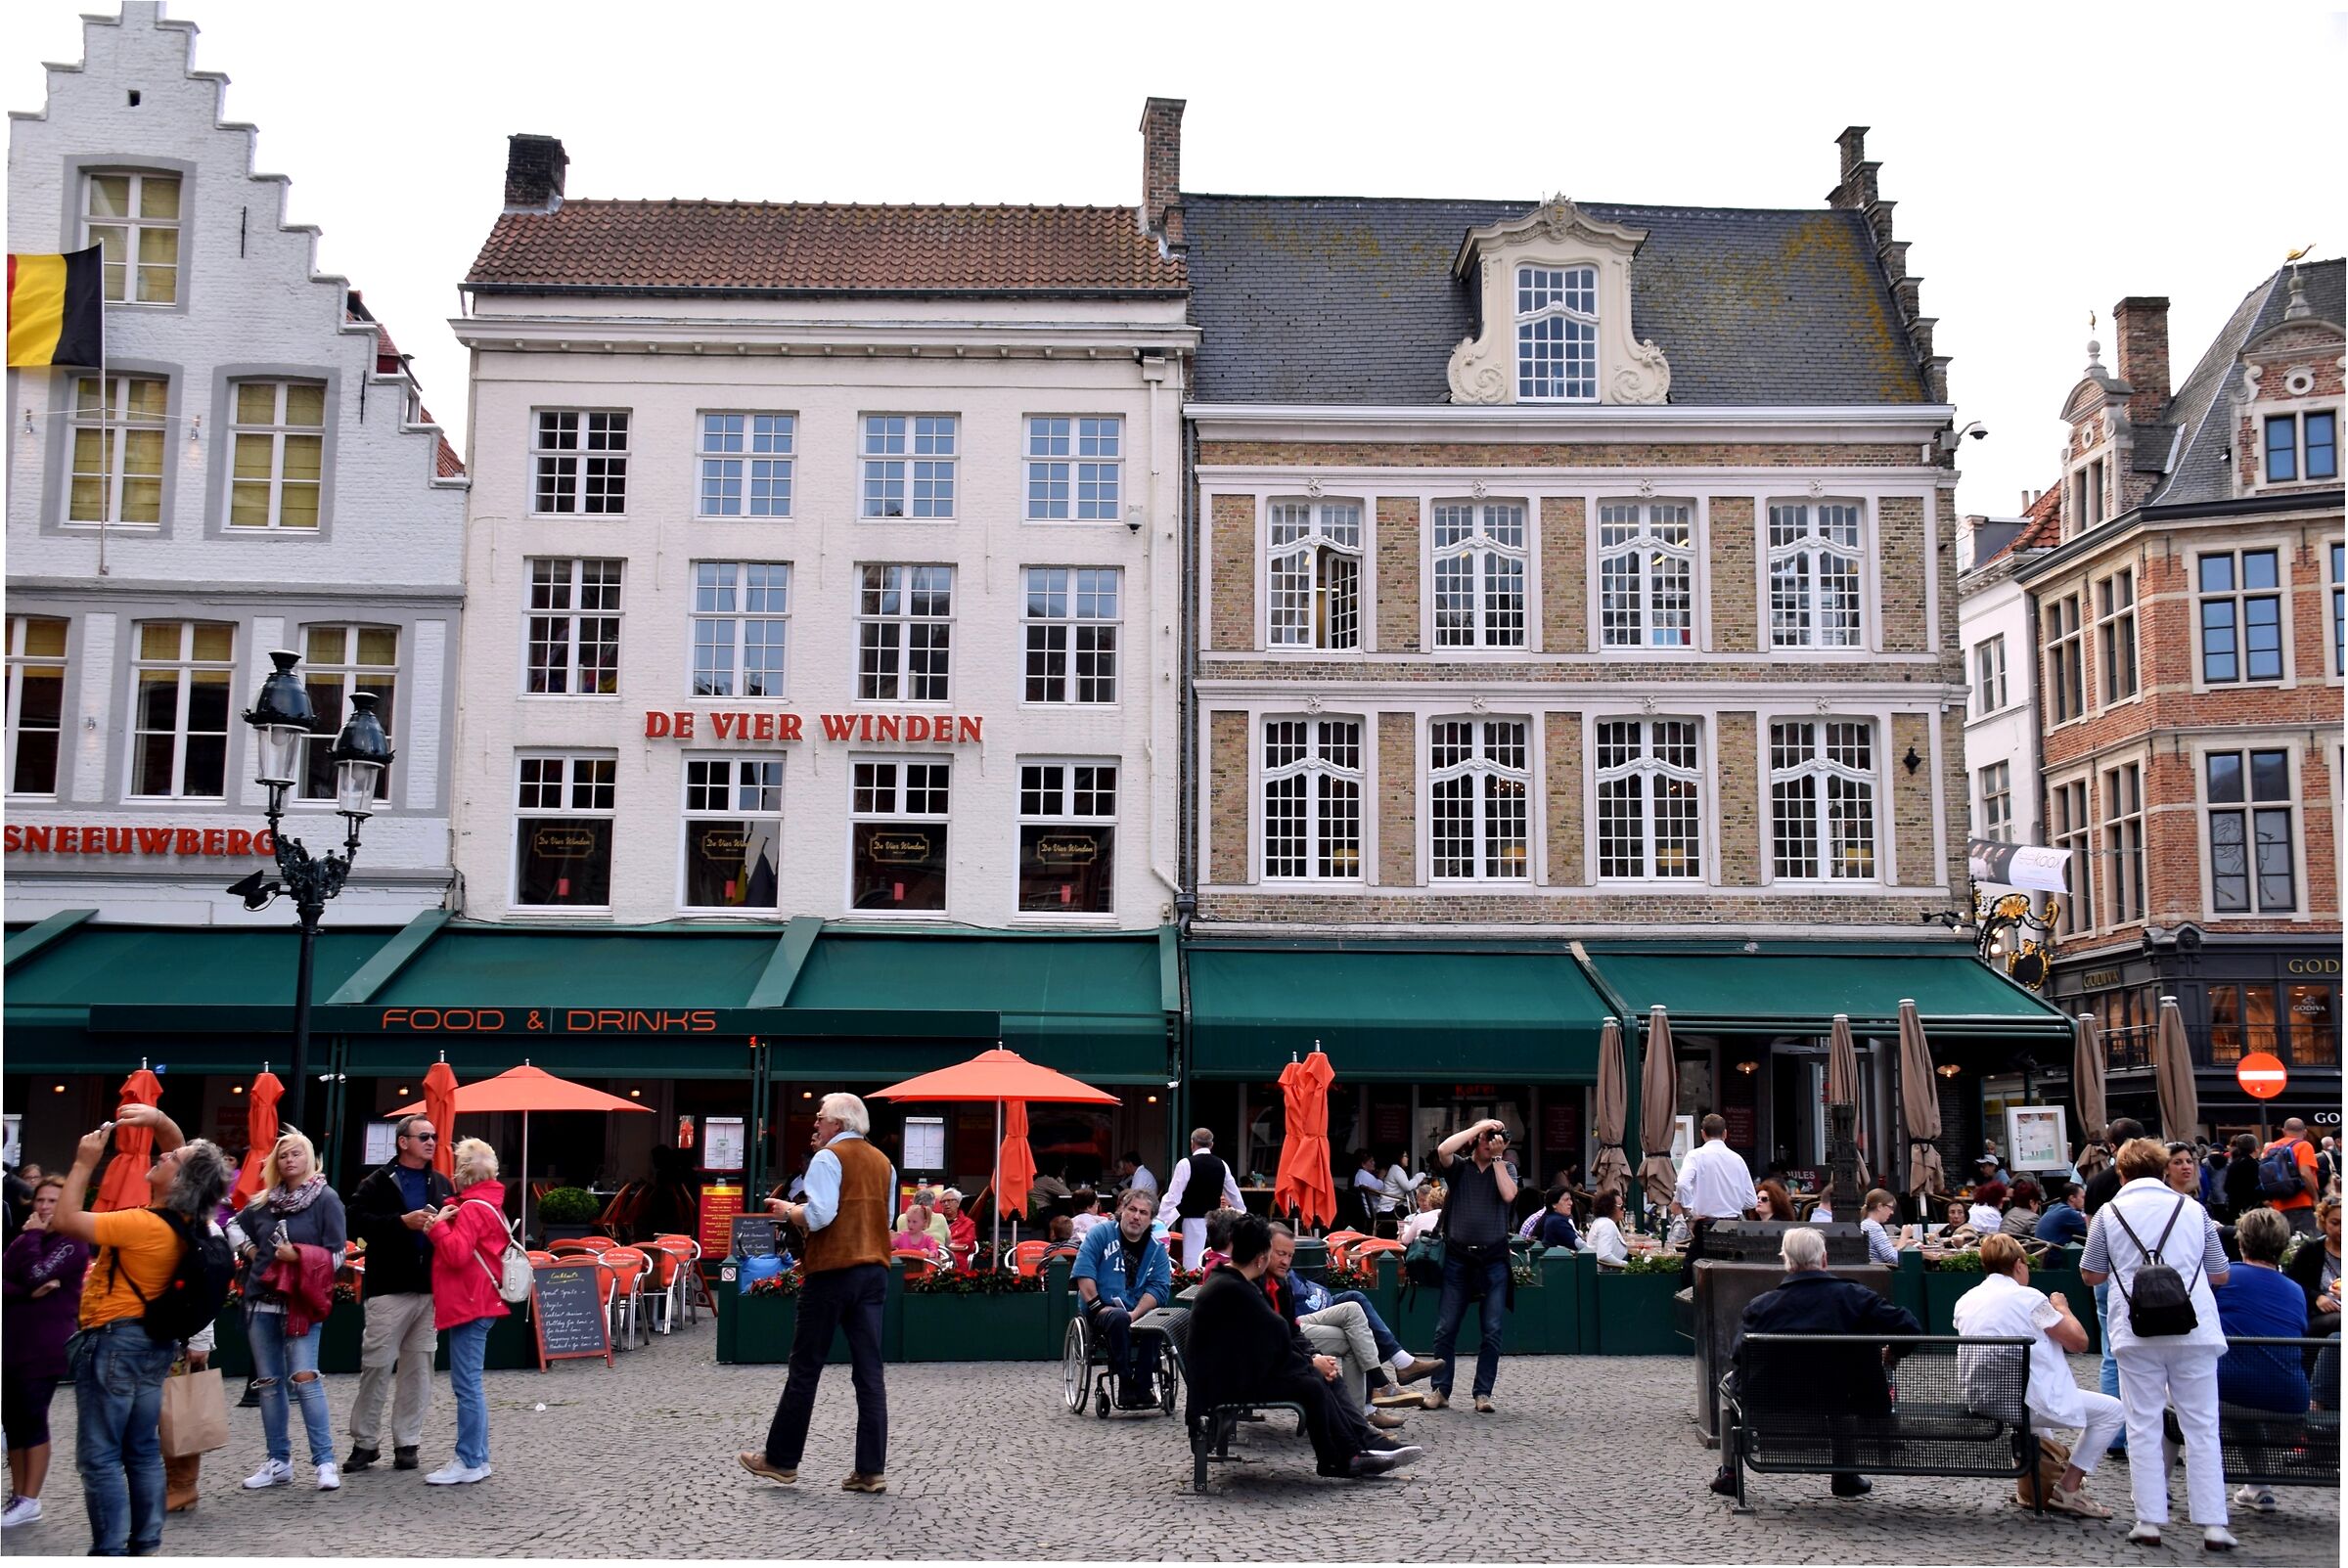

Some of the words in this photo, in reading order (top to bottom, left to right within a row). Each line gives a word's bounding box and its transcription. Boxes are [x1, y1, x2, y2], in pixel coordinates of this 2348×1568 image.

[645, 712, 696, 739] DE
[709, 713, 803, 742] VIER
[820, 714, 983, 743] WINDEN
[5, 825, 276, 856] SNEEUWBERG
[2288, 959, 2341, 973] GOD
[2084, 969, 2120, 988] GODIVA
[382, 1008, 505, 1030] FOOD
[526, 1010, 544, 1029] &
[567, 1010, 716, 1031] DRINKS
[2313, 1112, 2341, 1124] GO
